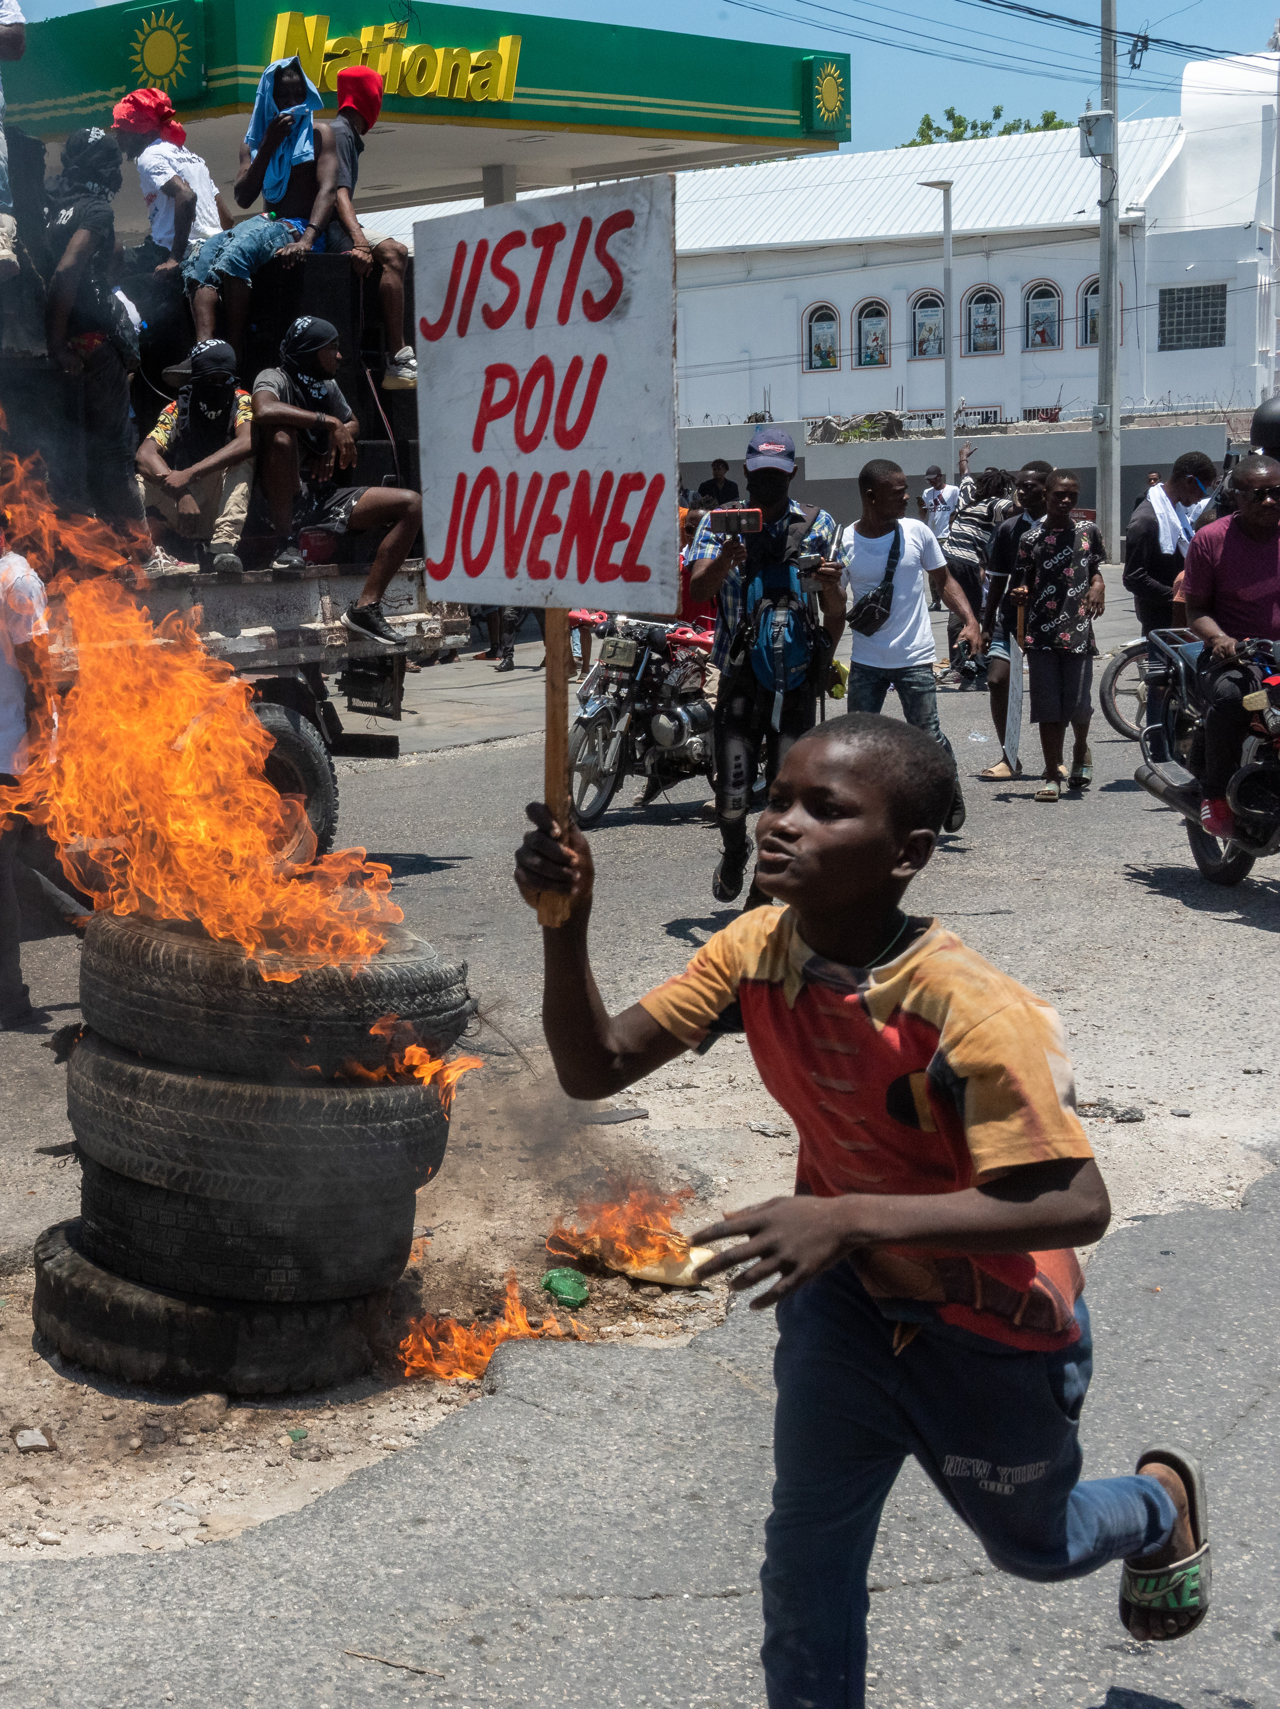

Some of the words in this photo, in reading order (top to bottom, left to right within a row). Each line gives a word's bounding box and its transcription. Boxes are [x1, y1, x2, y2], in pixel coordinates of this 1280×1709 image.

[271, 11, 522, 102] National
[420, 209, 635, 342] JISTIS
[472, 353, 608, 454] POU
[426, 466, 666, 585] JOVENEL
[942, 1454, 992, 1479] NEW
